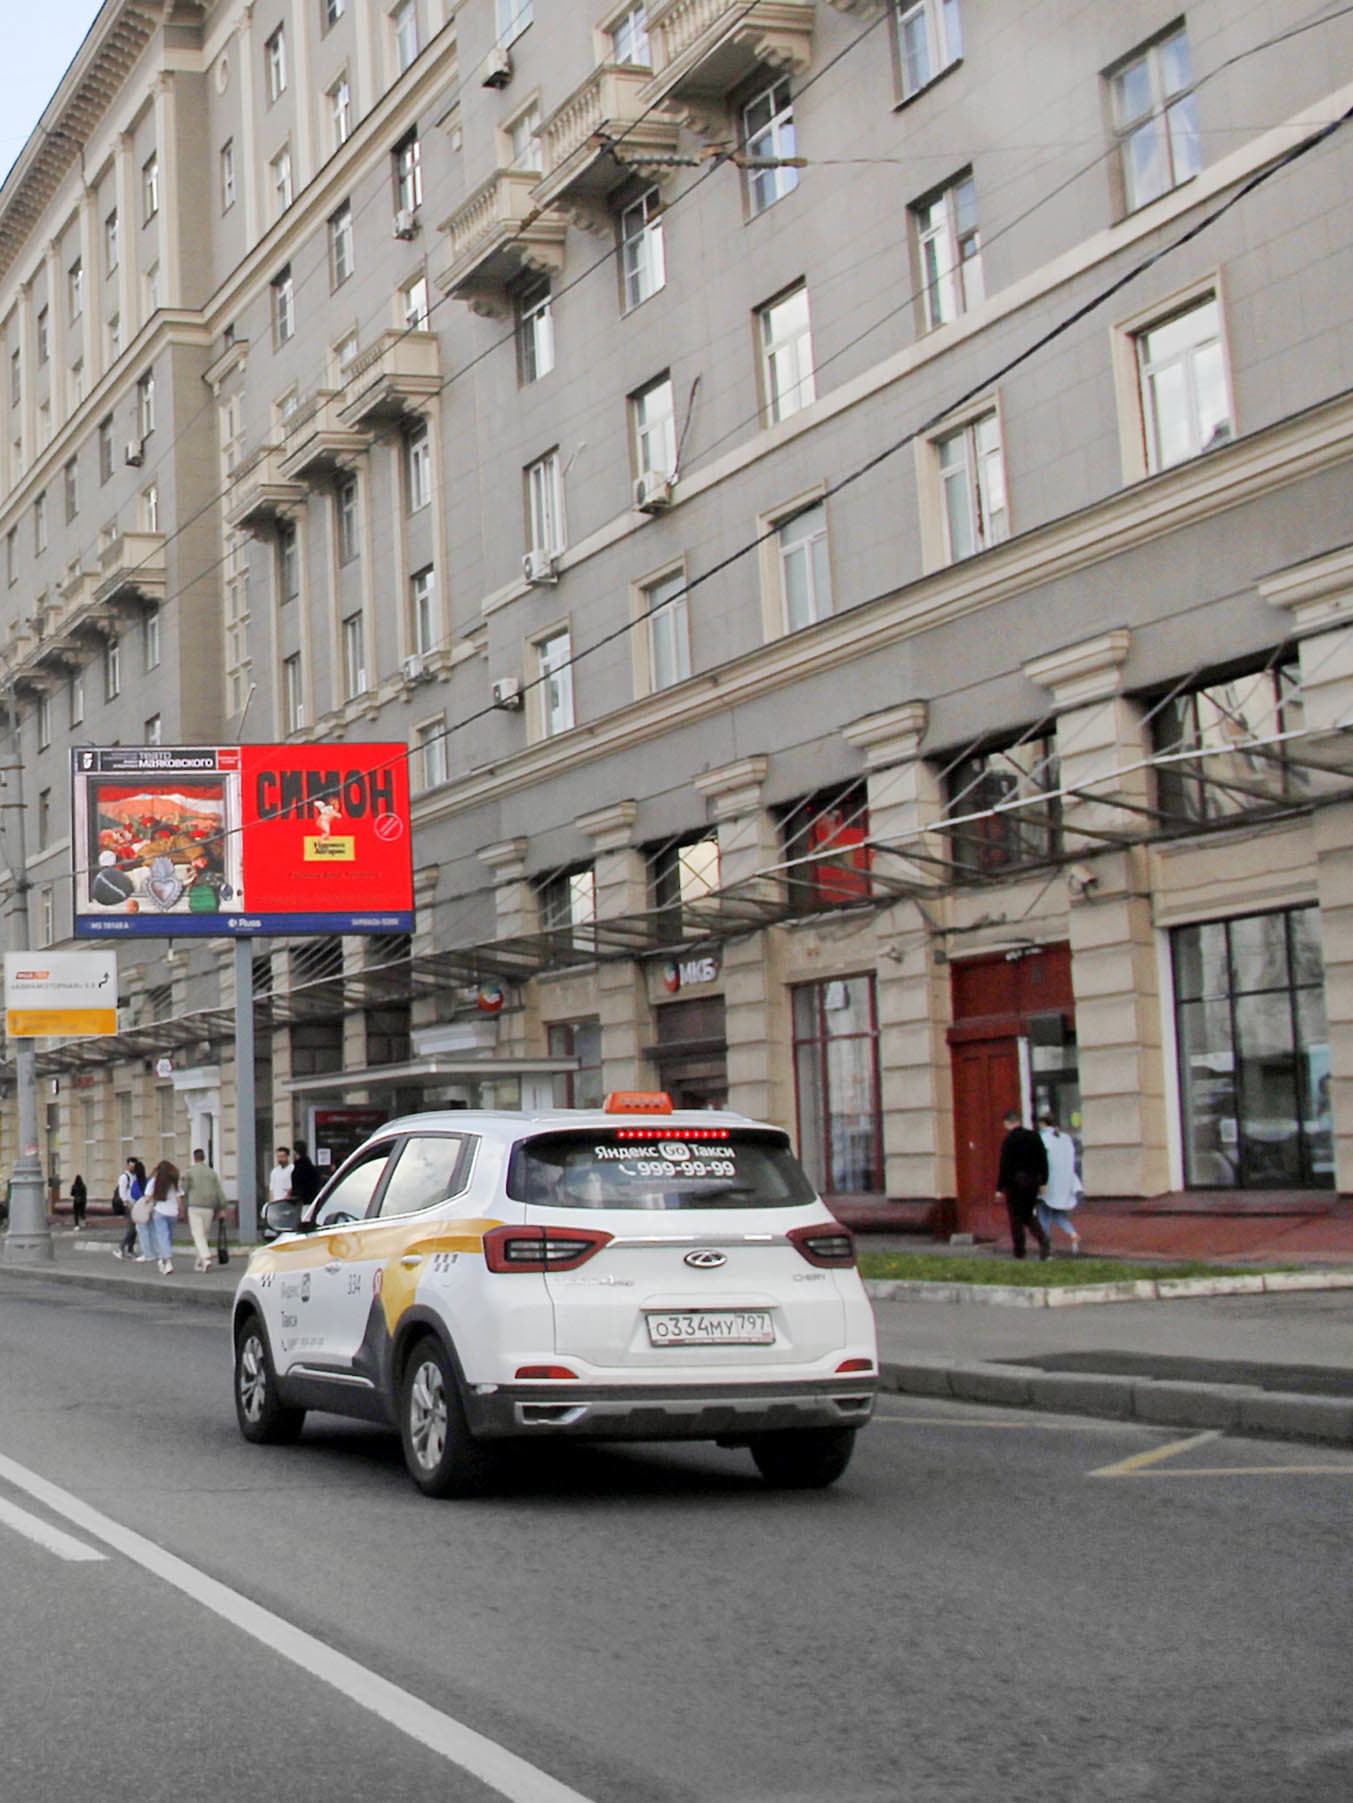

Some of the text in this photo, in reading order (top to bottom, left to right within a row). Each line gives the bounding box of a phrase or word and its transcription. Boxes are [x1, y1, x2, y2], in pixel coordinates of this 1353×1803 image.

[257, 769, 395, 820] СИМОН
[679, 957, 716, 986] МКБ
[594, 1145, 660, 1160] Яндекс
[688, 1143, 736, 1158] Такси
[637, 1160, 736, 1177] 999-99-99
[735, 1313, 766, 1331] 797
